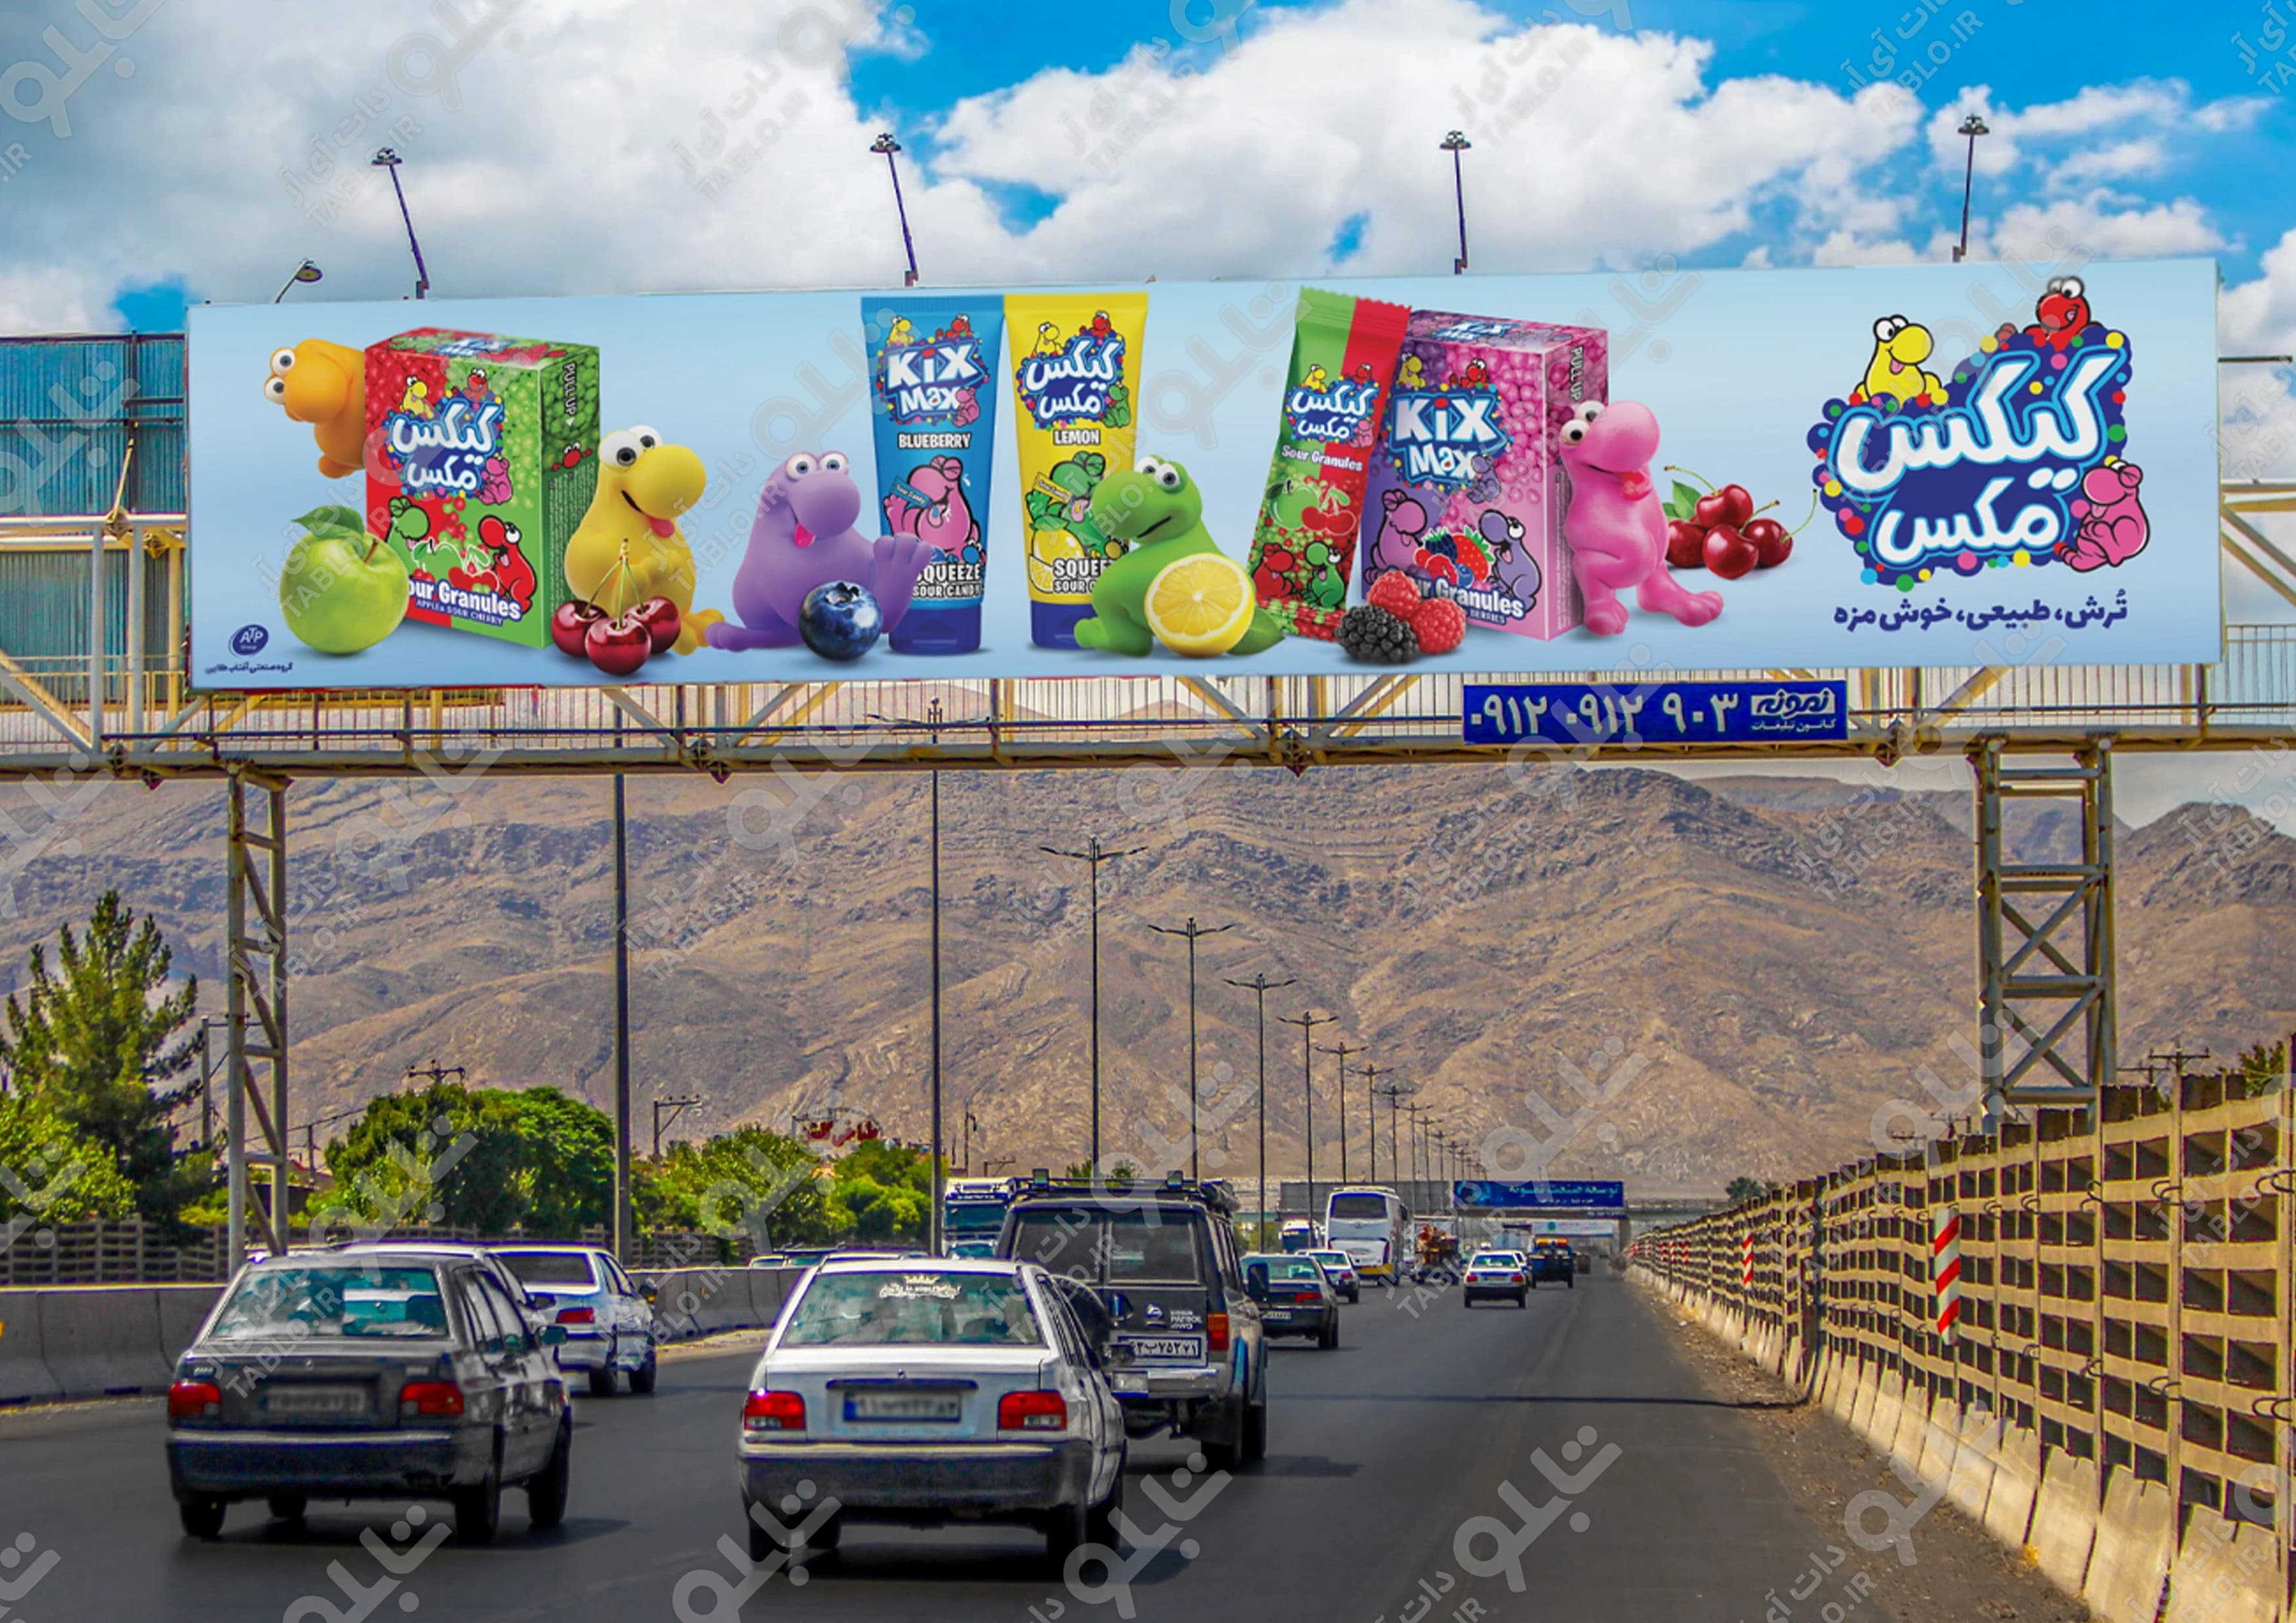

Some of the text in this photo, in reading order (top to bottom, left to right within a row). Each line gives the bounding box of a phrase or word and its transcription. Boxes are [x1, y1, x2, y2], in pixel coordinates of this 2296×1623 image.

[1571, 346, 1583, 400] PULL UP
[898, 433, 971, 449] BLUEBERRY
[1054, 431, 1100, 444] LEMON
[1282, 445, 1363, 471] Sour Granules
[913, 586, 942, 597] SOUR
[1054, 580, 1085, 592] SOUR
[409, 579, 521, 620] our Granules
[1834, 605, 1876, 633] مزه
[1879, 597, 1952, 632] خوش
[240, 627, 263, 644] ATP
